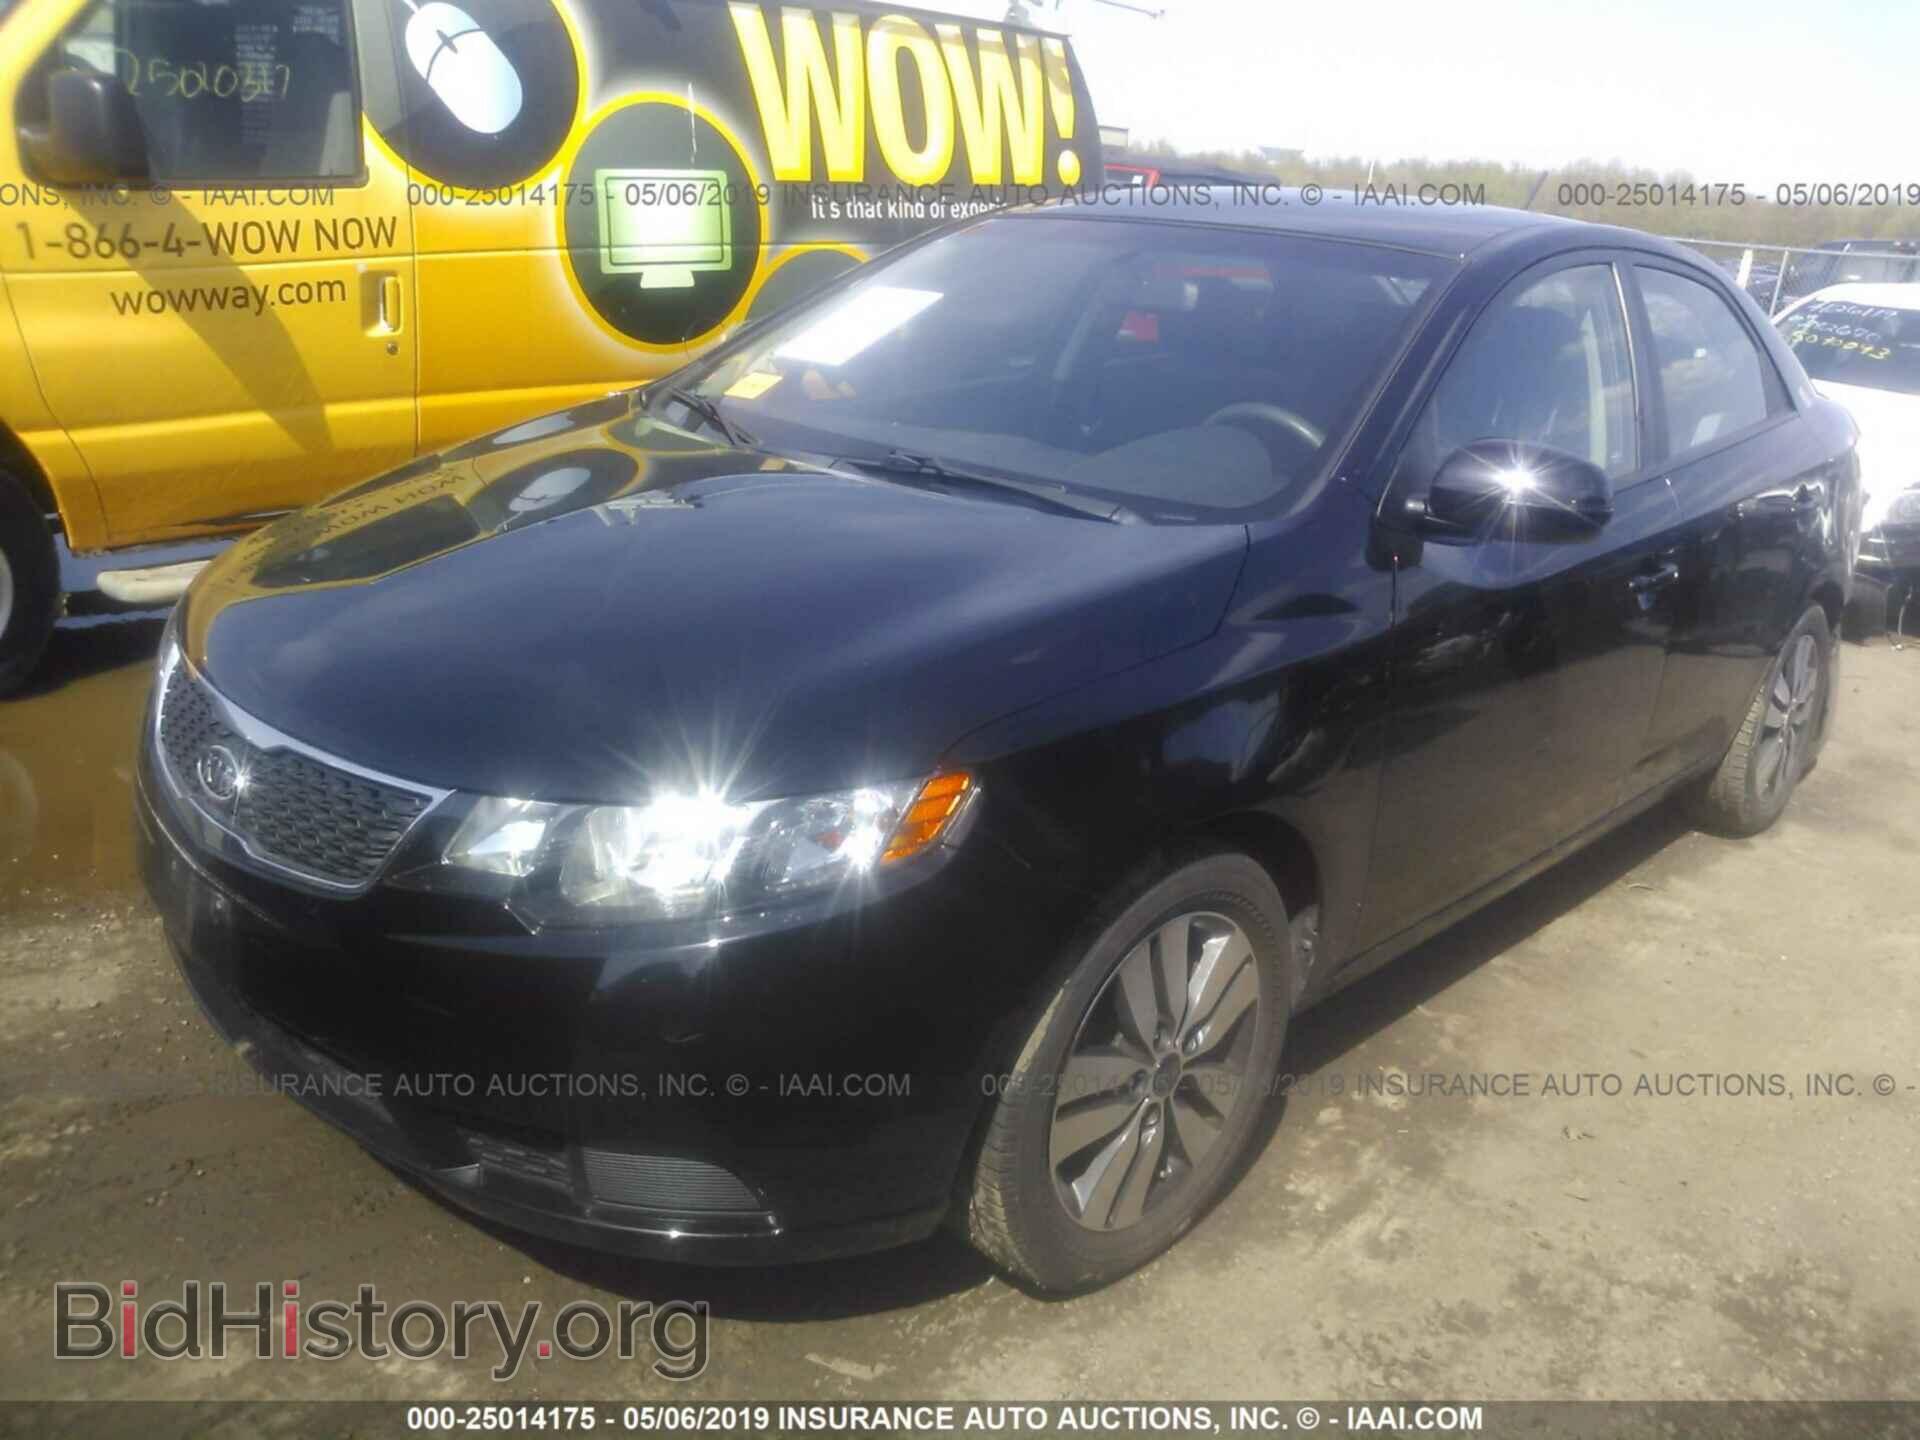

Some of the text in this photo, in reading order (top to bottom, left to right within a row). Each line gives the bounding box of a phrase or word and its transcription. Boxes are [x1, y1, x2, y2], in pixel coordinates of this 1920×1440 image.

[728, 1, 1081, 187] WOW!
[846, 194, 882, 219] that
[888, 195, 925, 219] kind
[930, 195, 946, 219] of
[17, 217, 397, 260] 1-866-4-WOW NOW
[110, 279, 346, 316] wowway.com
